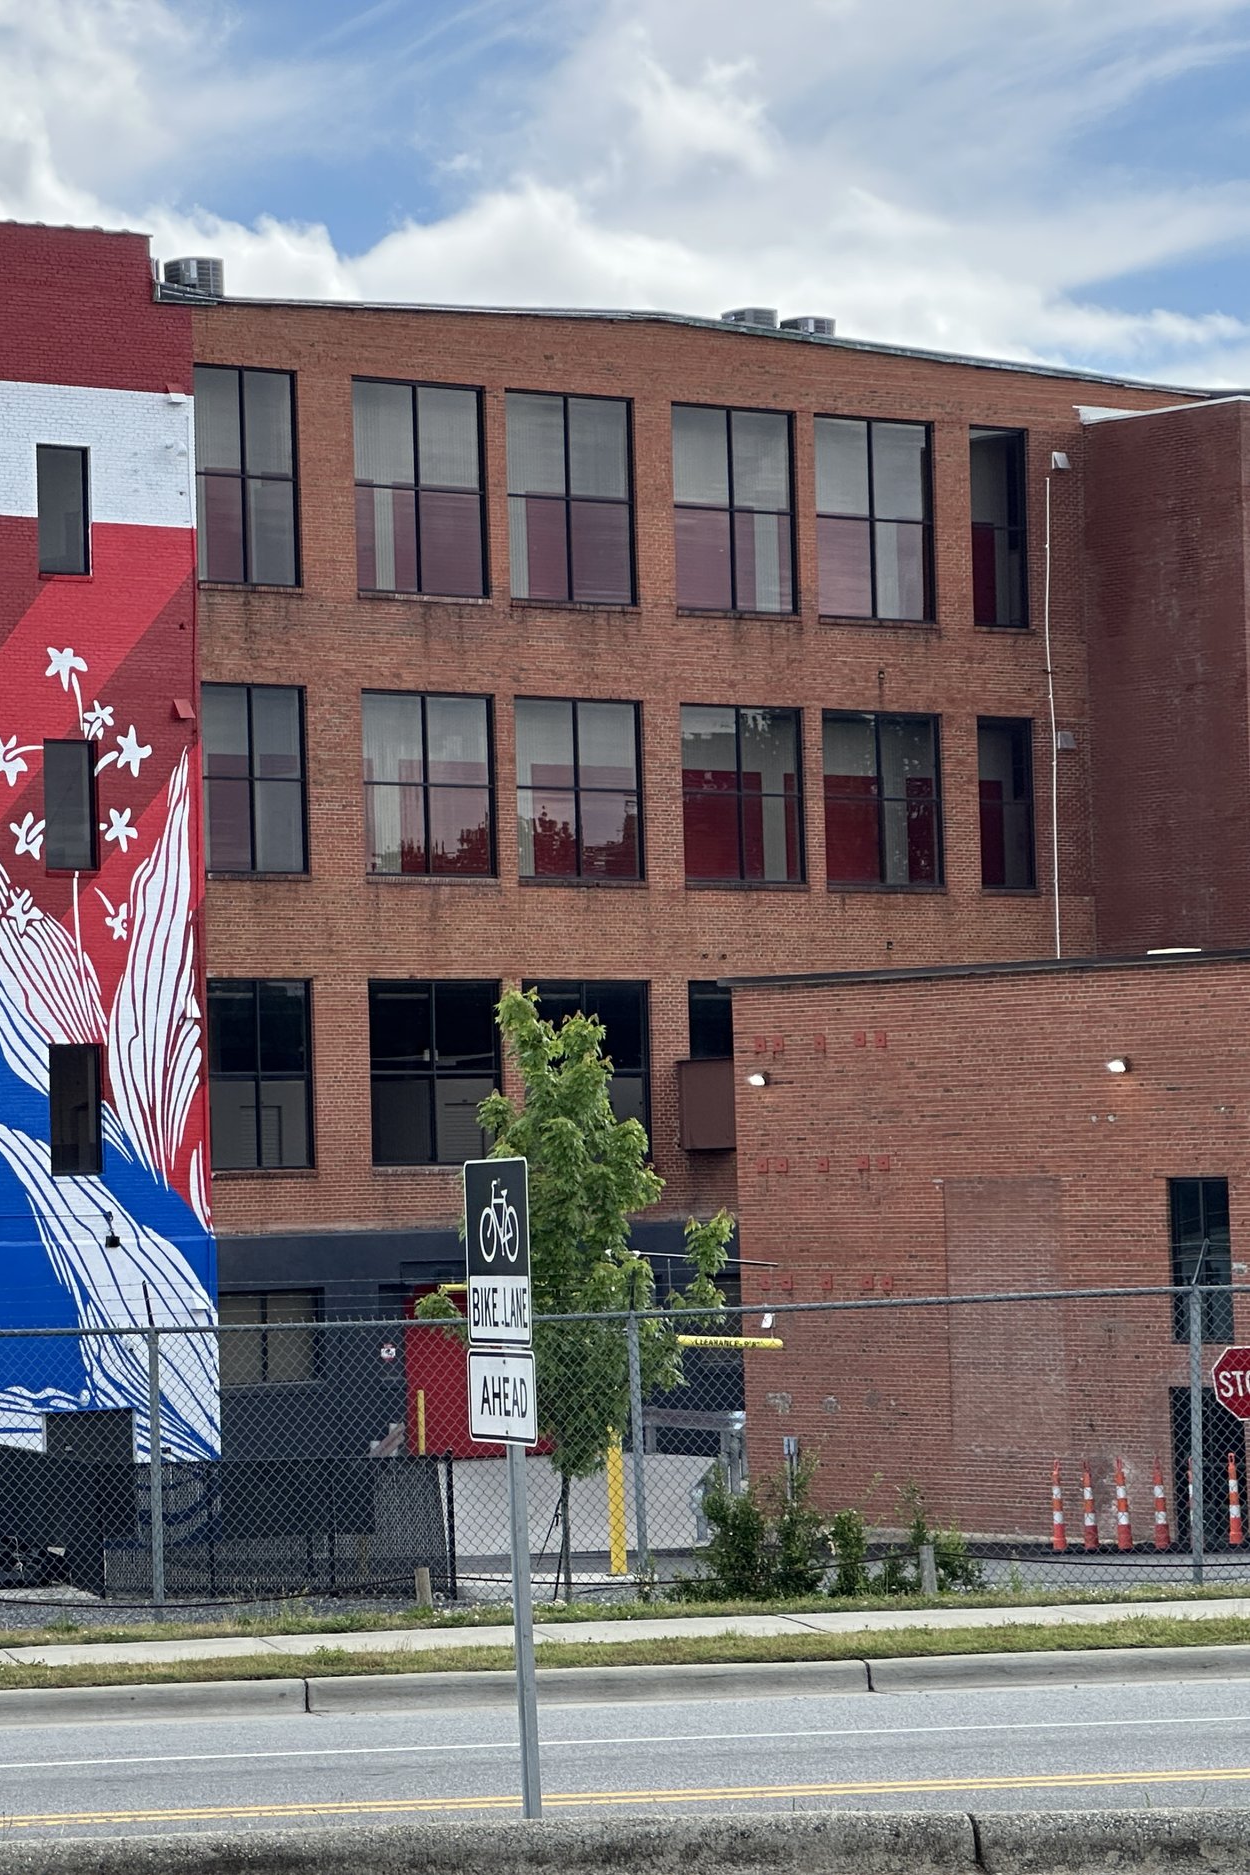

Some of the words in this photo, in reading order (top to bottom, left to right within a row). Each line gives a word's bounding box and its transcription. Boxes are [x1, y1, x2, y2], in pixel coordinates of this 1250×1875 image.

[472, 1287, 499, 1328] BIKE
[503, 1287, 528, 1328] LANE
[481, 1375, 527, 1418] AHEAD
